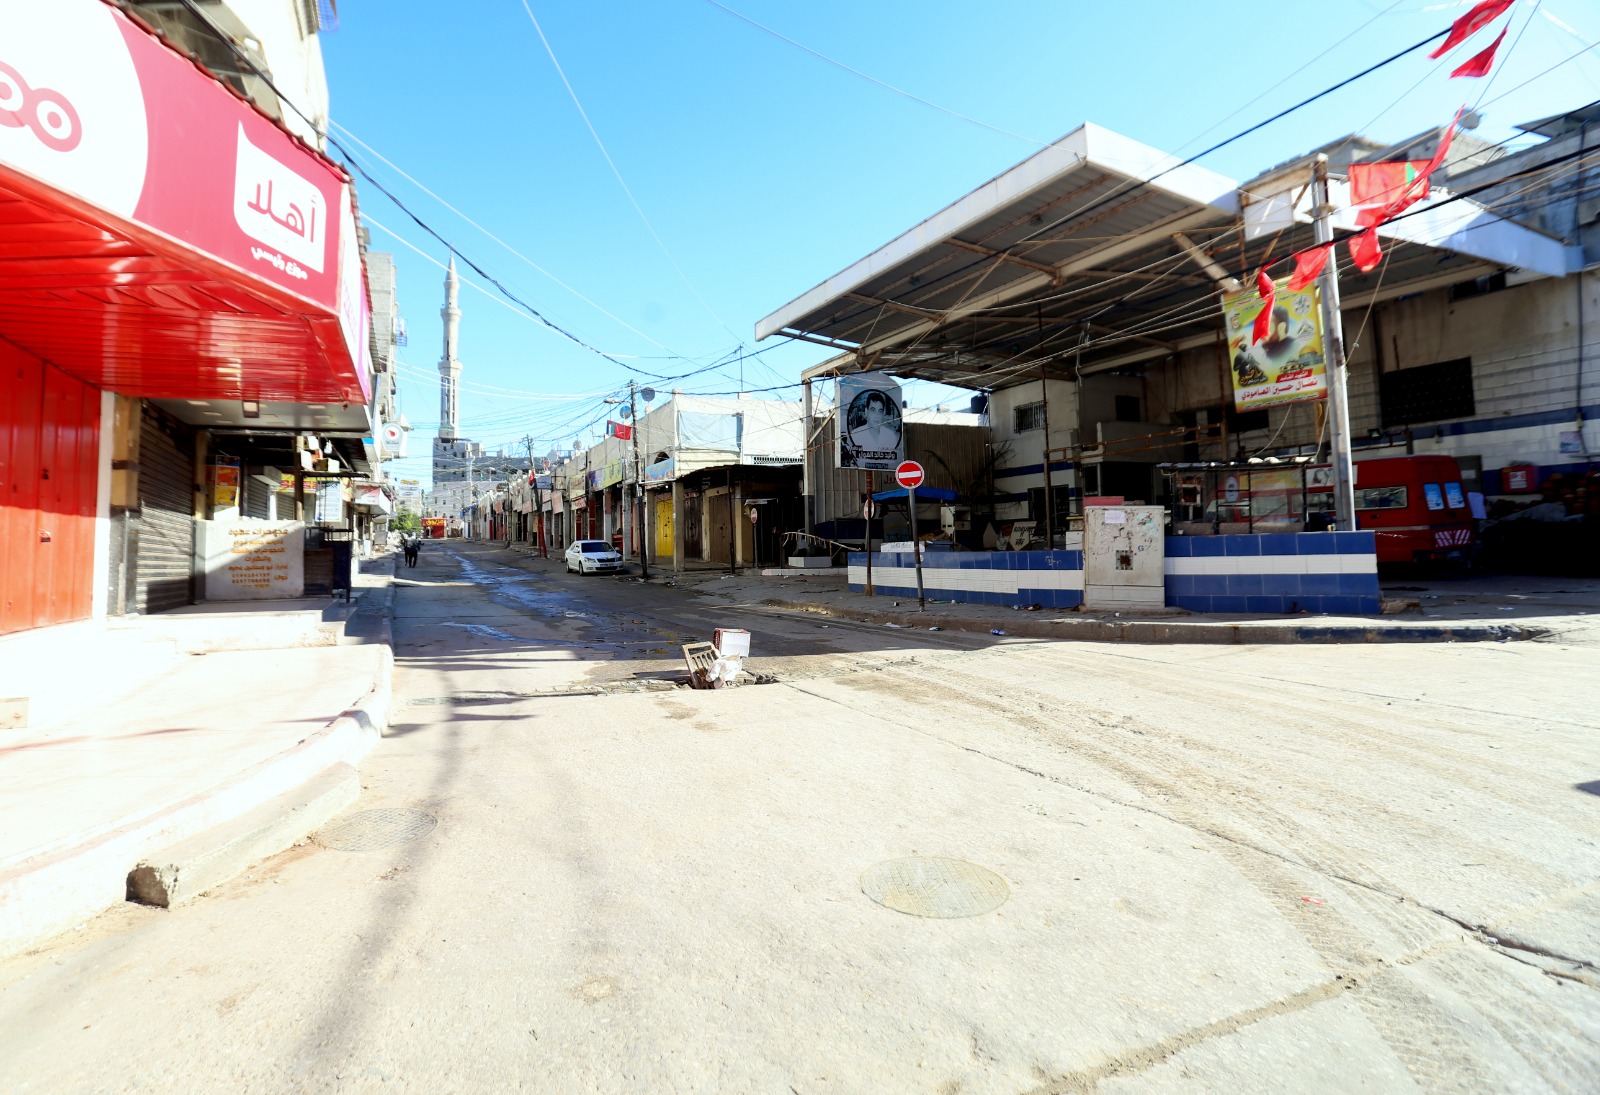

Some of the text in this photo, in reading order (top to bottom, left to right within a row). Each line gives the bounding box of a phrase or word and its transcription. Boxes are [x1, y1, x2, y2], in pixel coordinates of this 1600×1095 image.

[285, 261, 308, 280] موزع
[1273, 384, 1294, 396] حسين
[1296, 377, 1318, 390] نضال
[1241, 386, 1271, 401] العامودي
